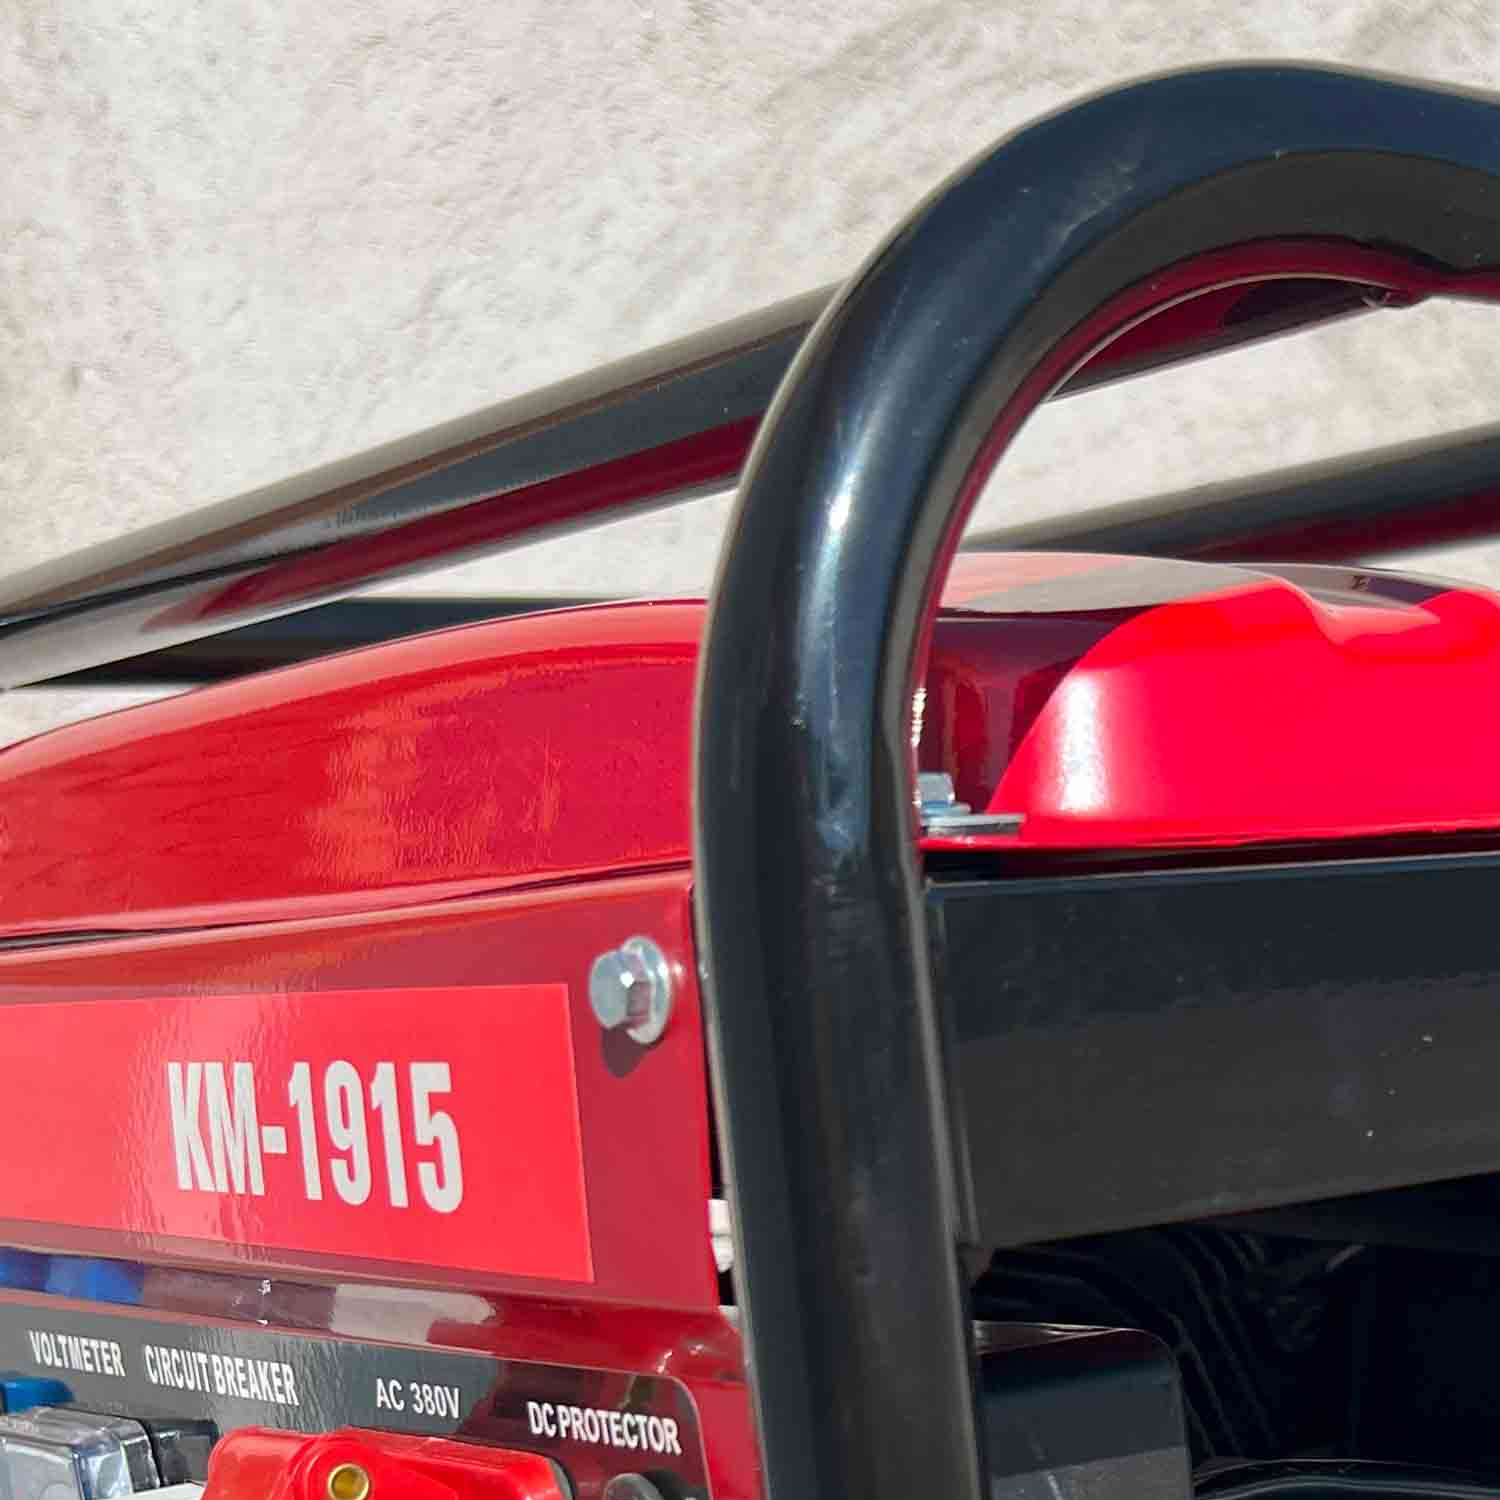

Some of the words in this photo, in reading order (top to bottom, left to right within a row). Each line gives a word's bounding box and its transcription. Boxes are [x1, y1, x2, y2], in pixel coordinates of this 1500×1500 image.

[167, 1059, 464, 1214] KM-1915
[29, 1329, 126, 1377] VOLTMETER
[144, 1344, 210, 1393] CIRCUIT
[211, 1353, 300, 1406] BREAKER
[375, 1378, 404, 1411] AC
[409, 1382, 460, 1419] 380V
[527, 1401, 555, 1436] DC
[557, 1404, 682, 1456] PROTECTOR
